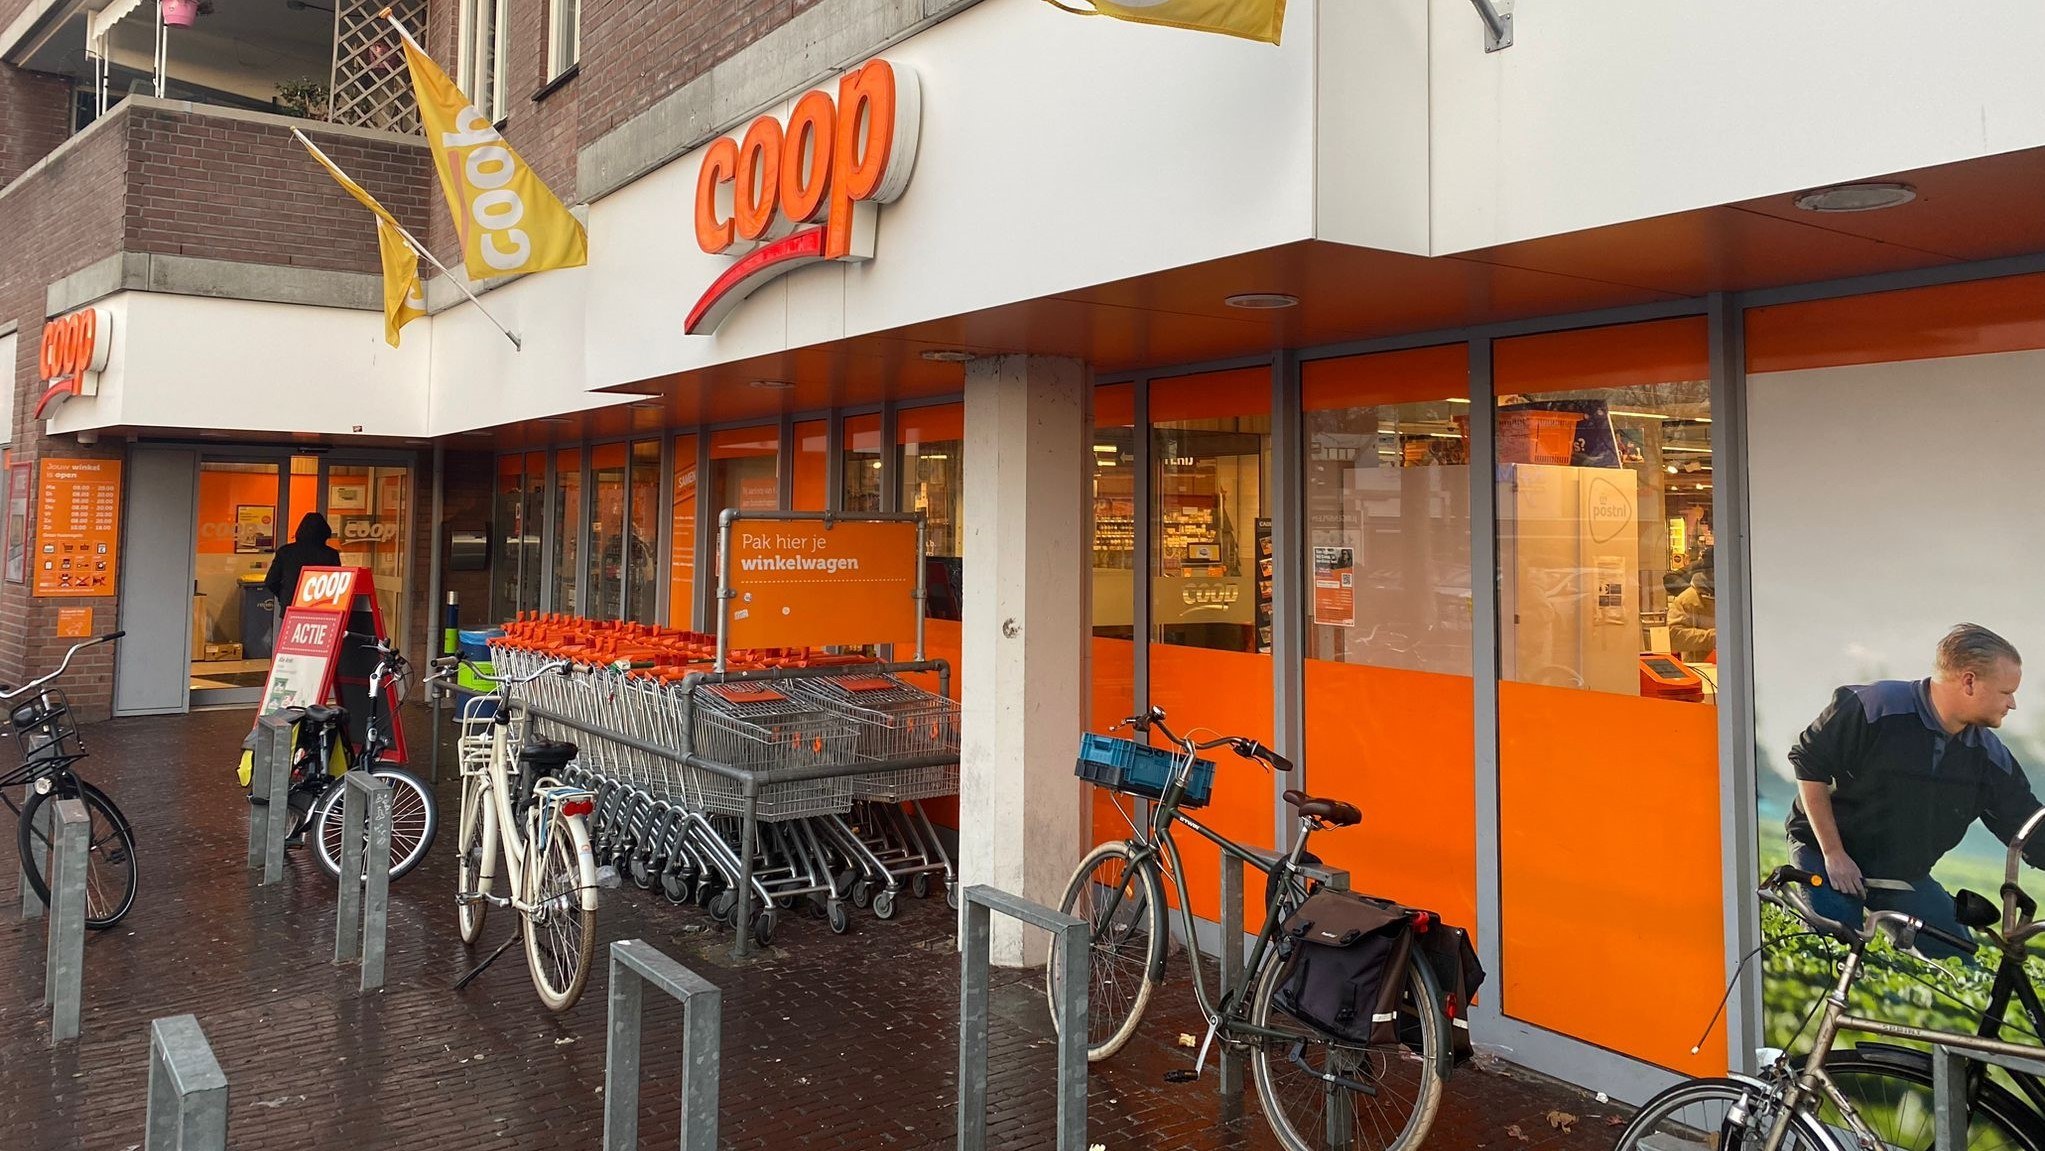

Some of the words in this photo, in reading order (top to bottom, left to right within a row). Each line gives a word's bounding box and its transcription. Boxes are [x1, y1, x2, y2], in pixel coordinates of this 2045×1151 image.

[695, 58, 897, 260] coop
[39, 306, 97, 396] coop
[1593, 504, 1628, 519] postnl
[344, 521, 397, 543] coop
[742, 533, 771, 550] Pak
[776, 532, 807, 549] hier
[810, 533, 827, 553] je
[741, 554, 859, 573] winkelwagen
[303, 571, 352, 605] coop
[1182, 583, 1239, 611] coop
[291, 623, 327, 645] ACTIE
